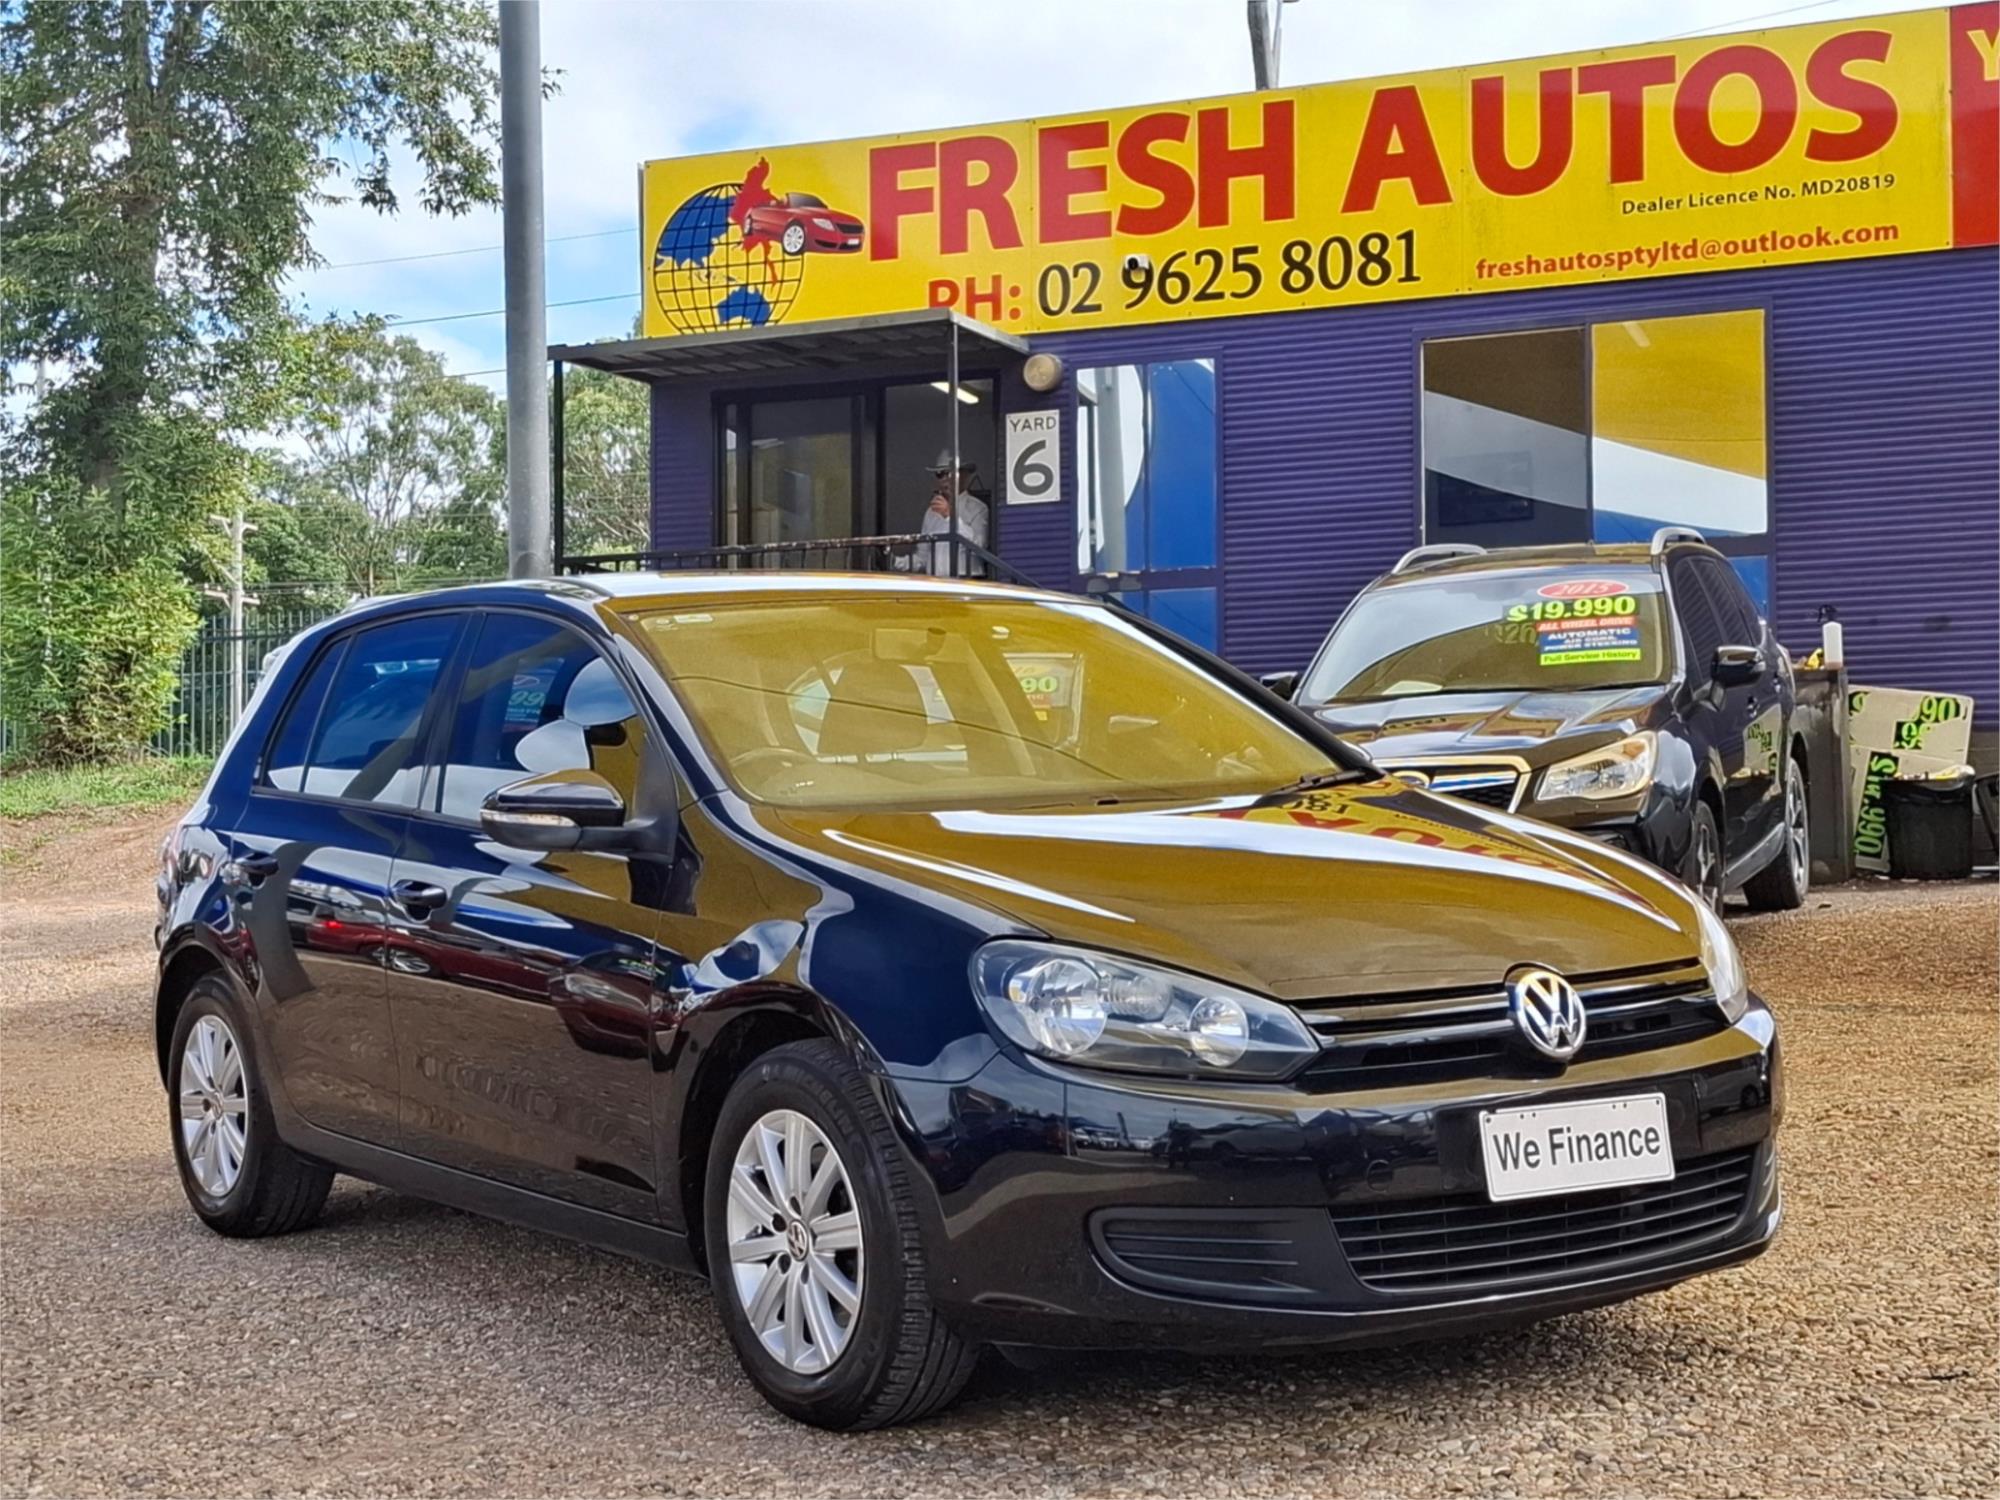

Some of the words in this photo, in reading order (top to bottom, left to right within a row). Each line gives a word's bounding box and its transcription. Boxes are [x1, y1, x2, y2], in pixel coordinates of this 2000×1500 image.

[869, 99, 1296, 261] FRESH
[1340, 29, 1899, 214] AUTOS
[1621, 197, 1682, 215] Dealer
[1688, 188, 1759, 208] Licence
[1764, 182, 1797, 201] No.
[1801, 173, 1896, 197] MD20819
[1038, 262, 1102, 316] 02
[1121, 245, 1262, 309] 9625
[1280, 229, 1421, 294] 8081
[1475, 222, 1900, 280] freshautosptyltd@outlook.com
[1009, 416, 1056, 432] YARD
[1013, 439, 1054, 496] 6
[1553, 583, 1612, 597] 2015
[1548, 627, 1632, 640] AUTOMATIC
[1602, 649, 1637, 659] History
[1493, 1131, 1541, 1171] We
[1548, 1125, 1661, 1165] Finance
